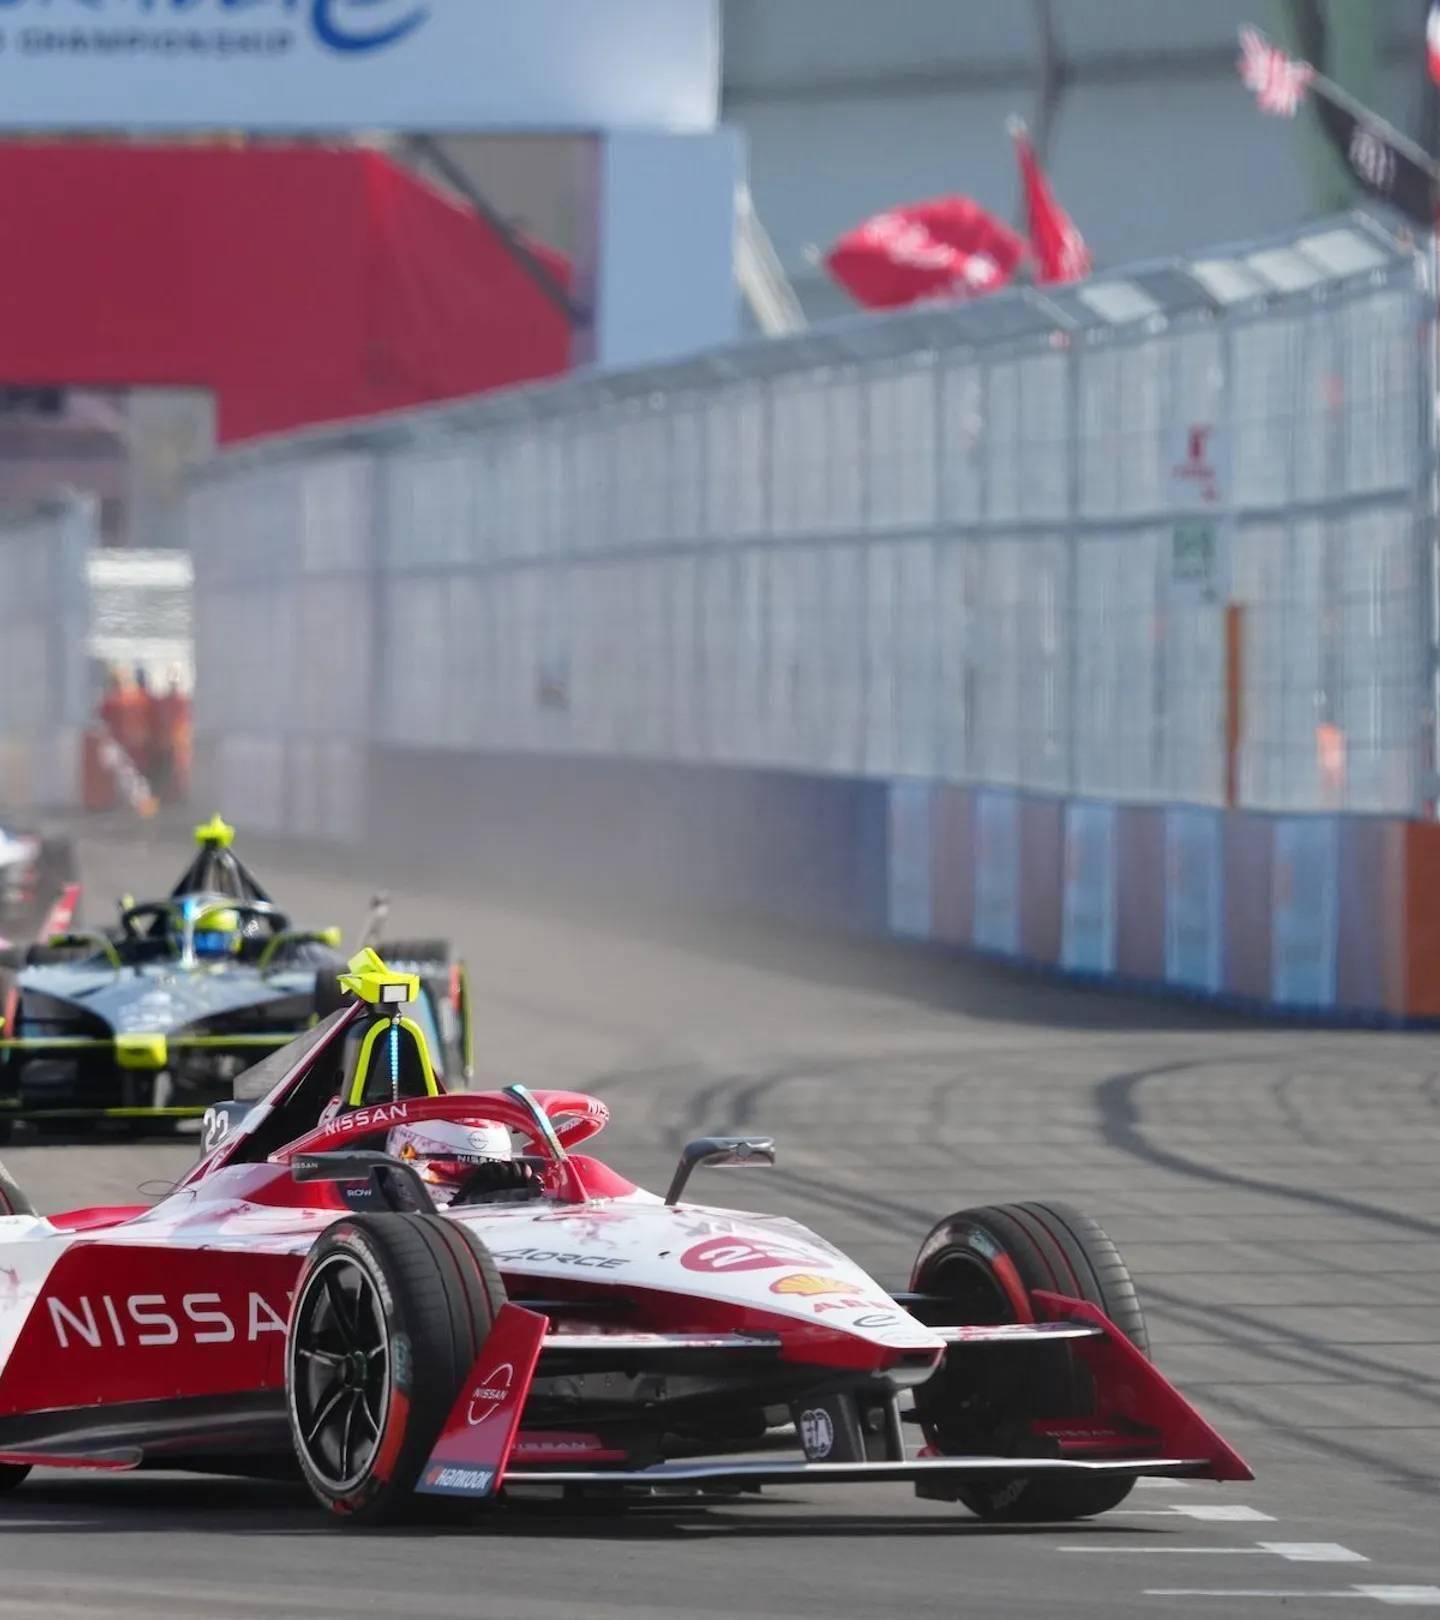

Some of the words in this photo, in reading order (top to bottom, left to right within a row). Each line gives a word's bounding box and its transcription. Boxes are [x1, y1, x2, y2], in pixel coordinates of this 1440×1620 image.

[324, 1102, 408, 1137] NISSAN
[46, 1291, 294, 1348] NISSA
[802, 1418, 831, 1448] FIA
